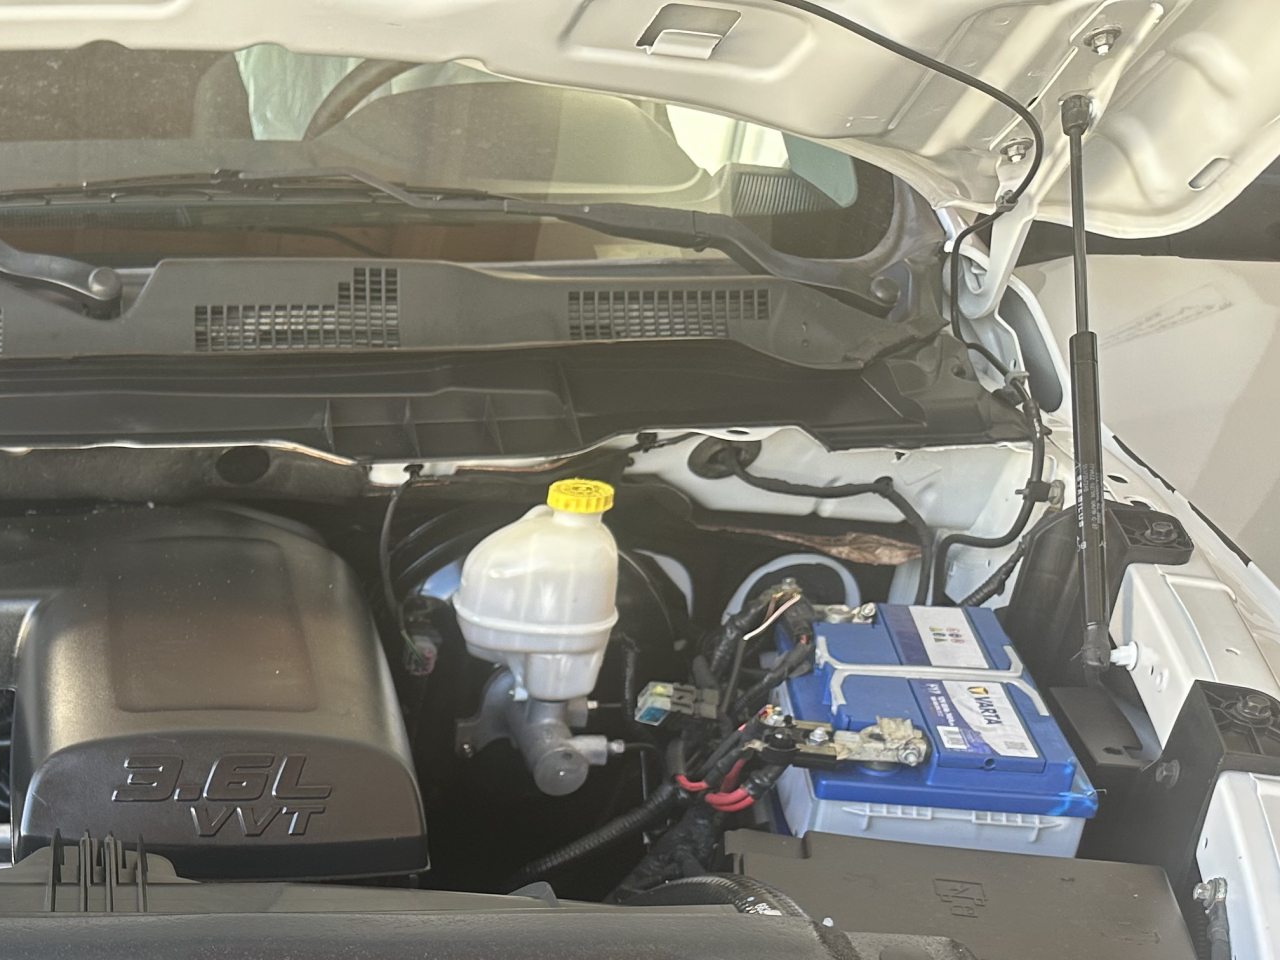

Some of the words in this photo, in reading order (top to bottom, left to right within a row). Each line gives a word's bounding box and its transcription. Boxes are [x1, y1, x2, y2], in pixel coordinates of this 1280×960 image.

[973, 696, 1003, 726] VARTA
[112, 754, 332, 802] 3.6L
[190, 804, 327, 838] VVT
